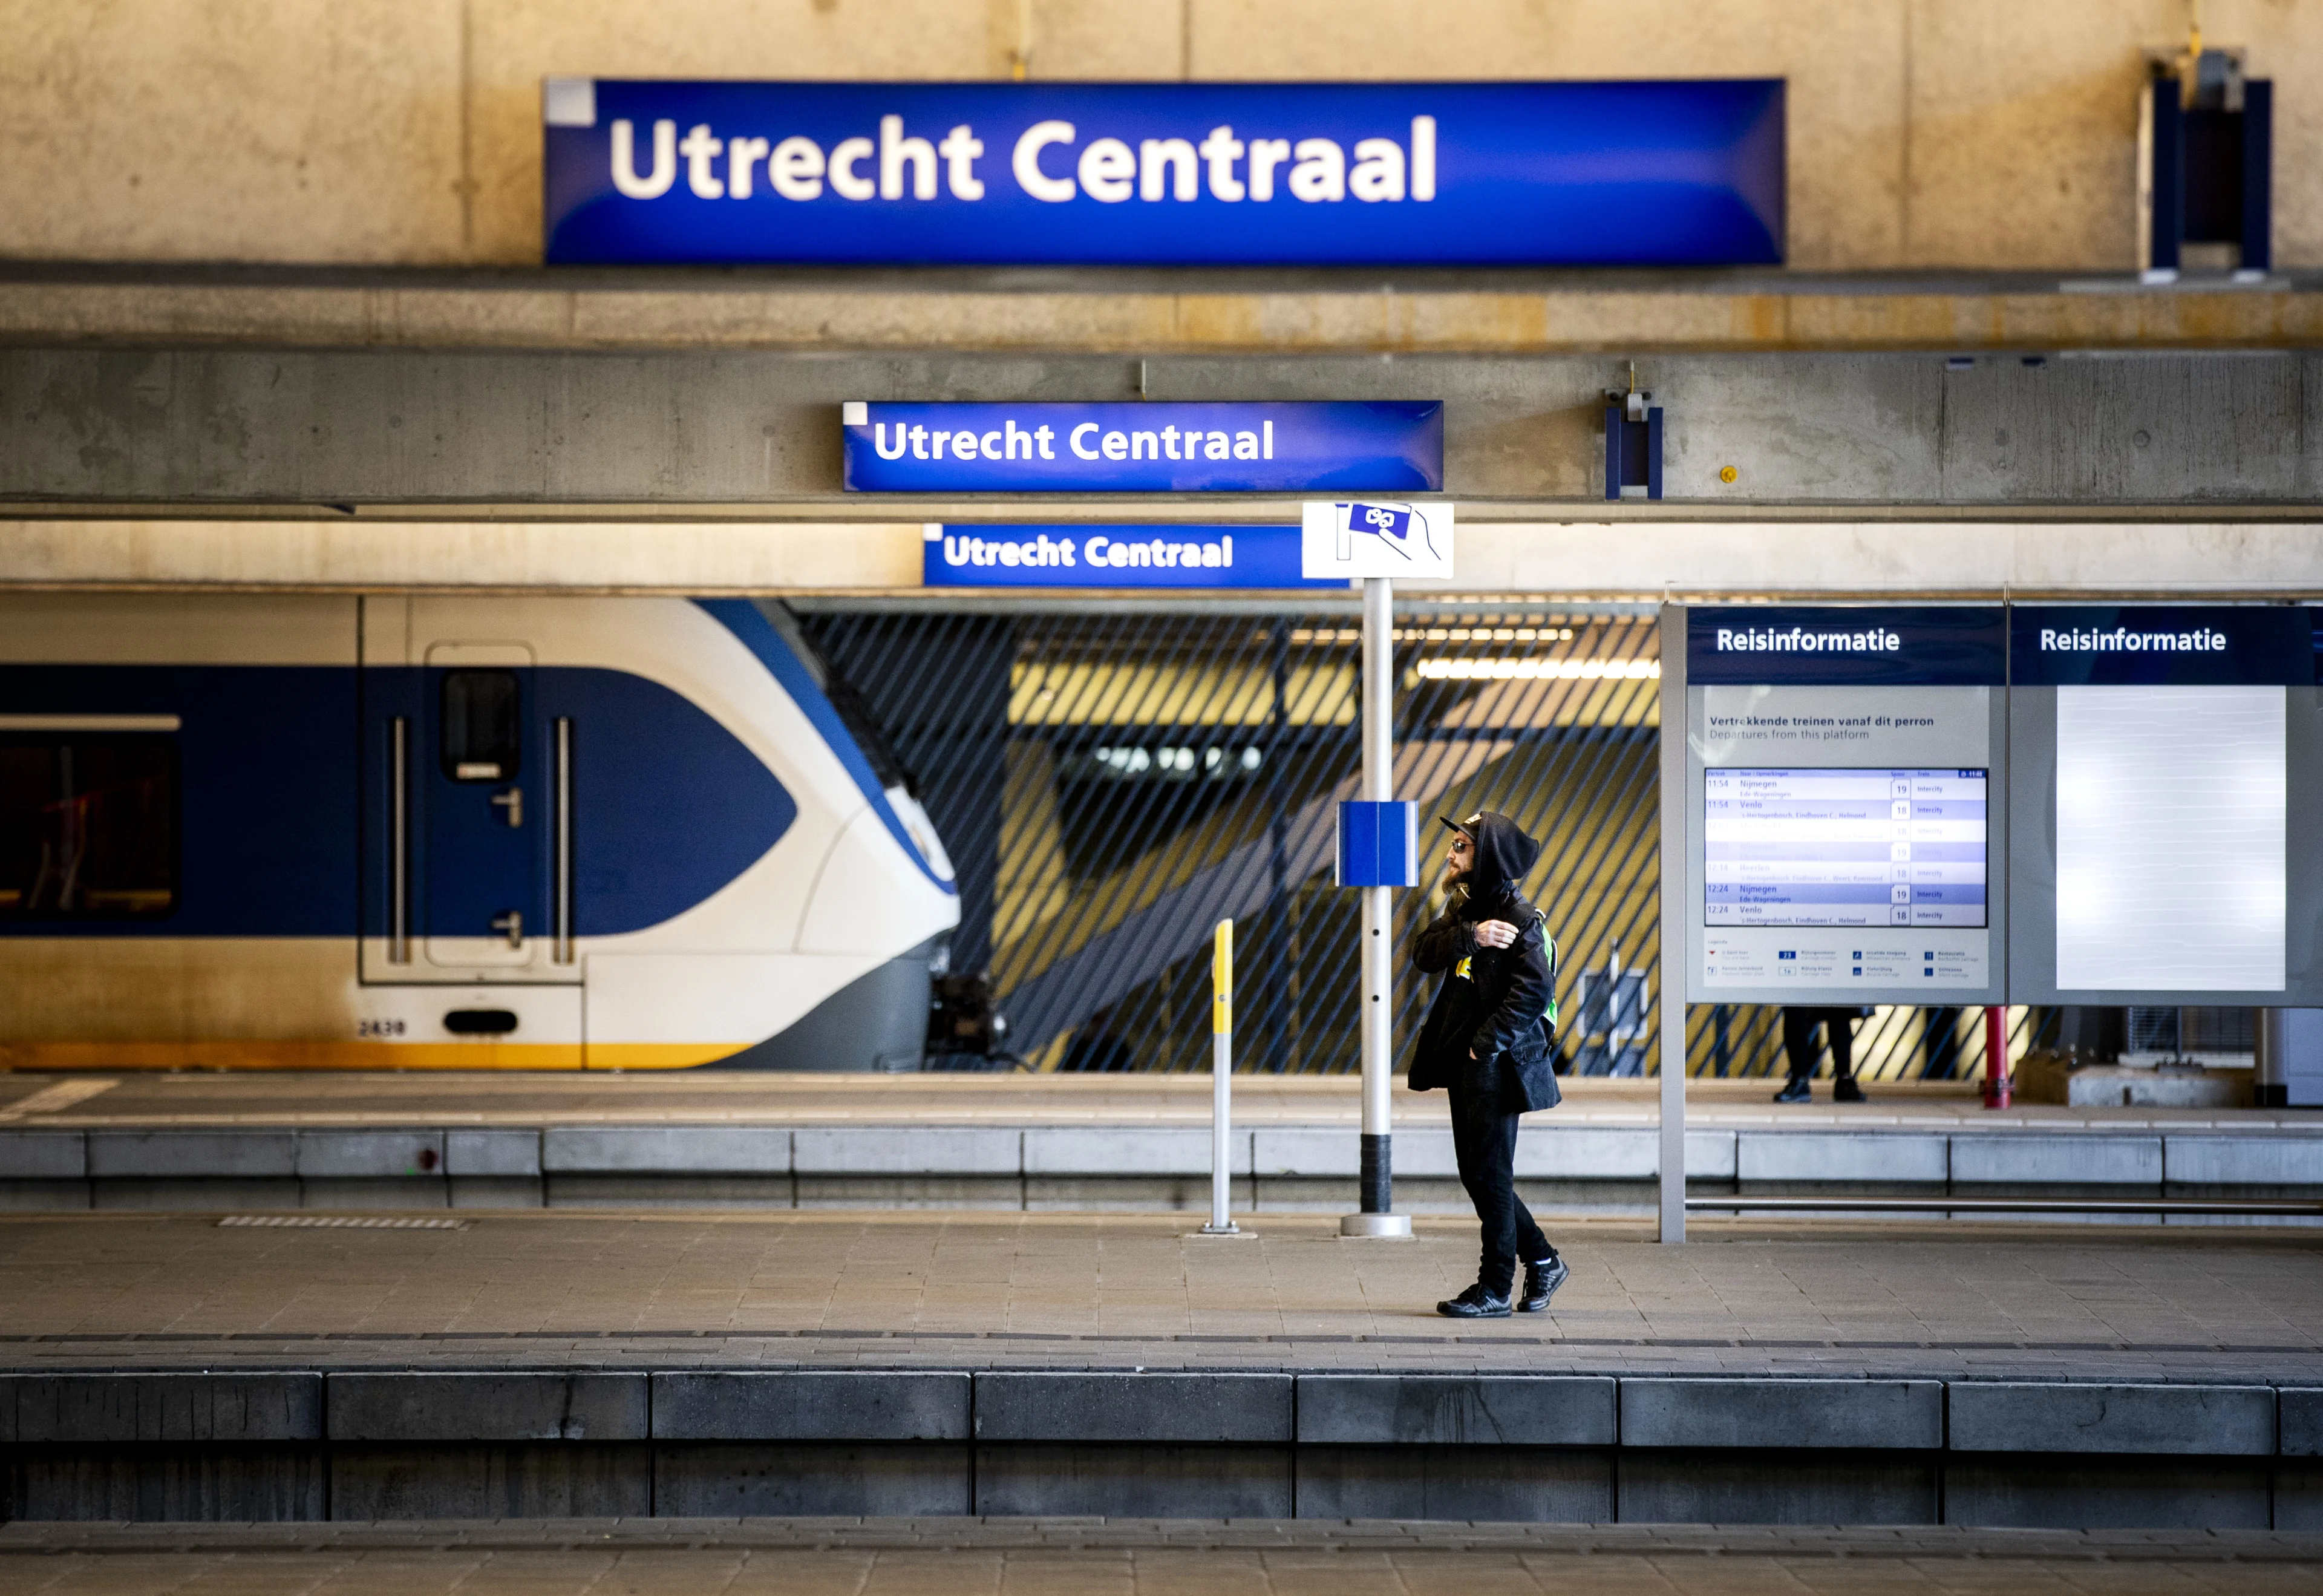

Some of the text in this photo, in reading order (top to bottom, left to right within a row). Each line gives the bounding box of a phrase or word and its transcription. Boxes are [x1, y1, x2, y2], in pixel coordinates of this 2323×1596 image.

[612, 116, 1436, 203] Utrecht Centraal
[874, 420, 1274, 460] Utrecht Centraal
[943, 535, 1233, 568] Utrecht Centraal
[1717, 627, 1900, 651] Reisinformatie
[2040, 627, 2226, 651] Reisinformatie
[1710, 717, 1934, 728] Vertrekkende treinen vanaf dit perron
[1710, 730, 1869, 741] Departures from this platform
[1740, 780, 1777, 789] Nijmegen
[1897, 785, 1907, 794] 19
[1897, 849, 1906, 857] 19
[1740, 885, 1777, 894] Nijmegen
